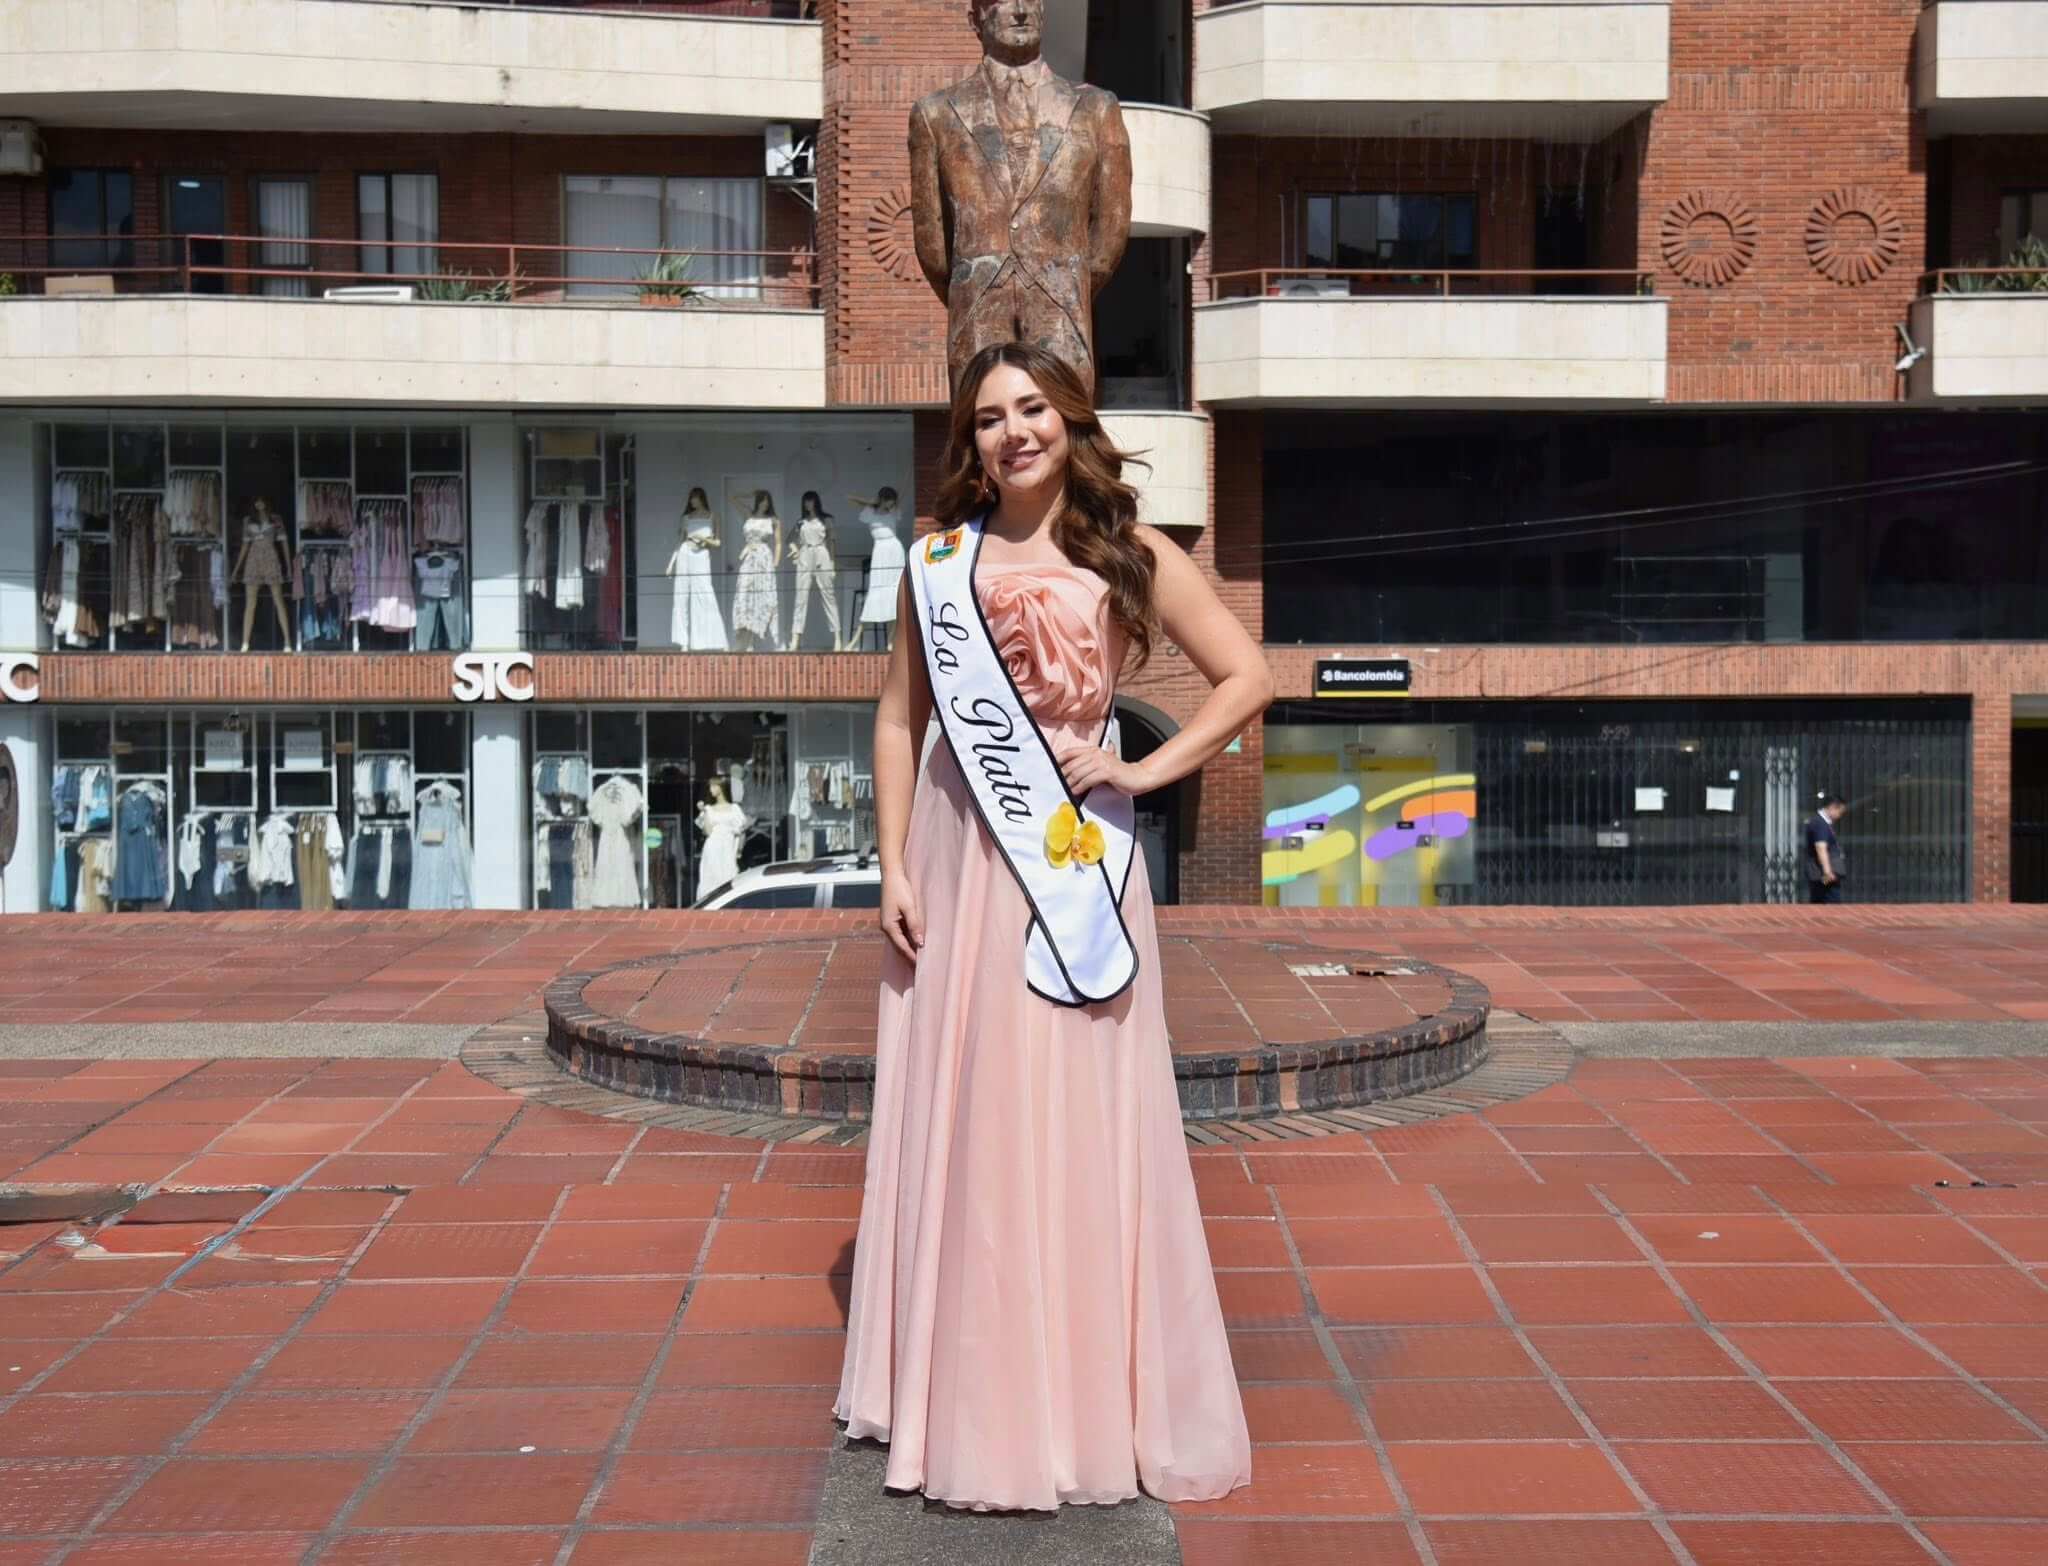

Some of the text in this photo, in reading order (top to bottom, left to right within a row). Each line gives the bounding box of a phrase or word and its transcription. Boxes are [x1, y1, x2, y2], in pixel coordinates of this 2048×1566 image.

[452, 652, 534, 702] STC
[1333, 670, 1404, 681] Bancolombia
[929, 602, 1033, 824] La Plata
